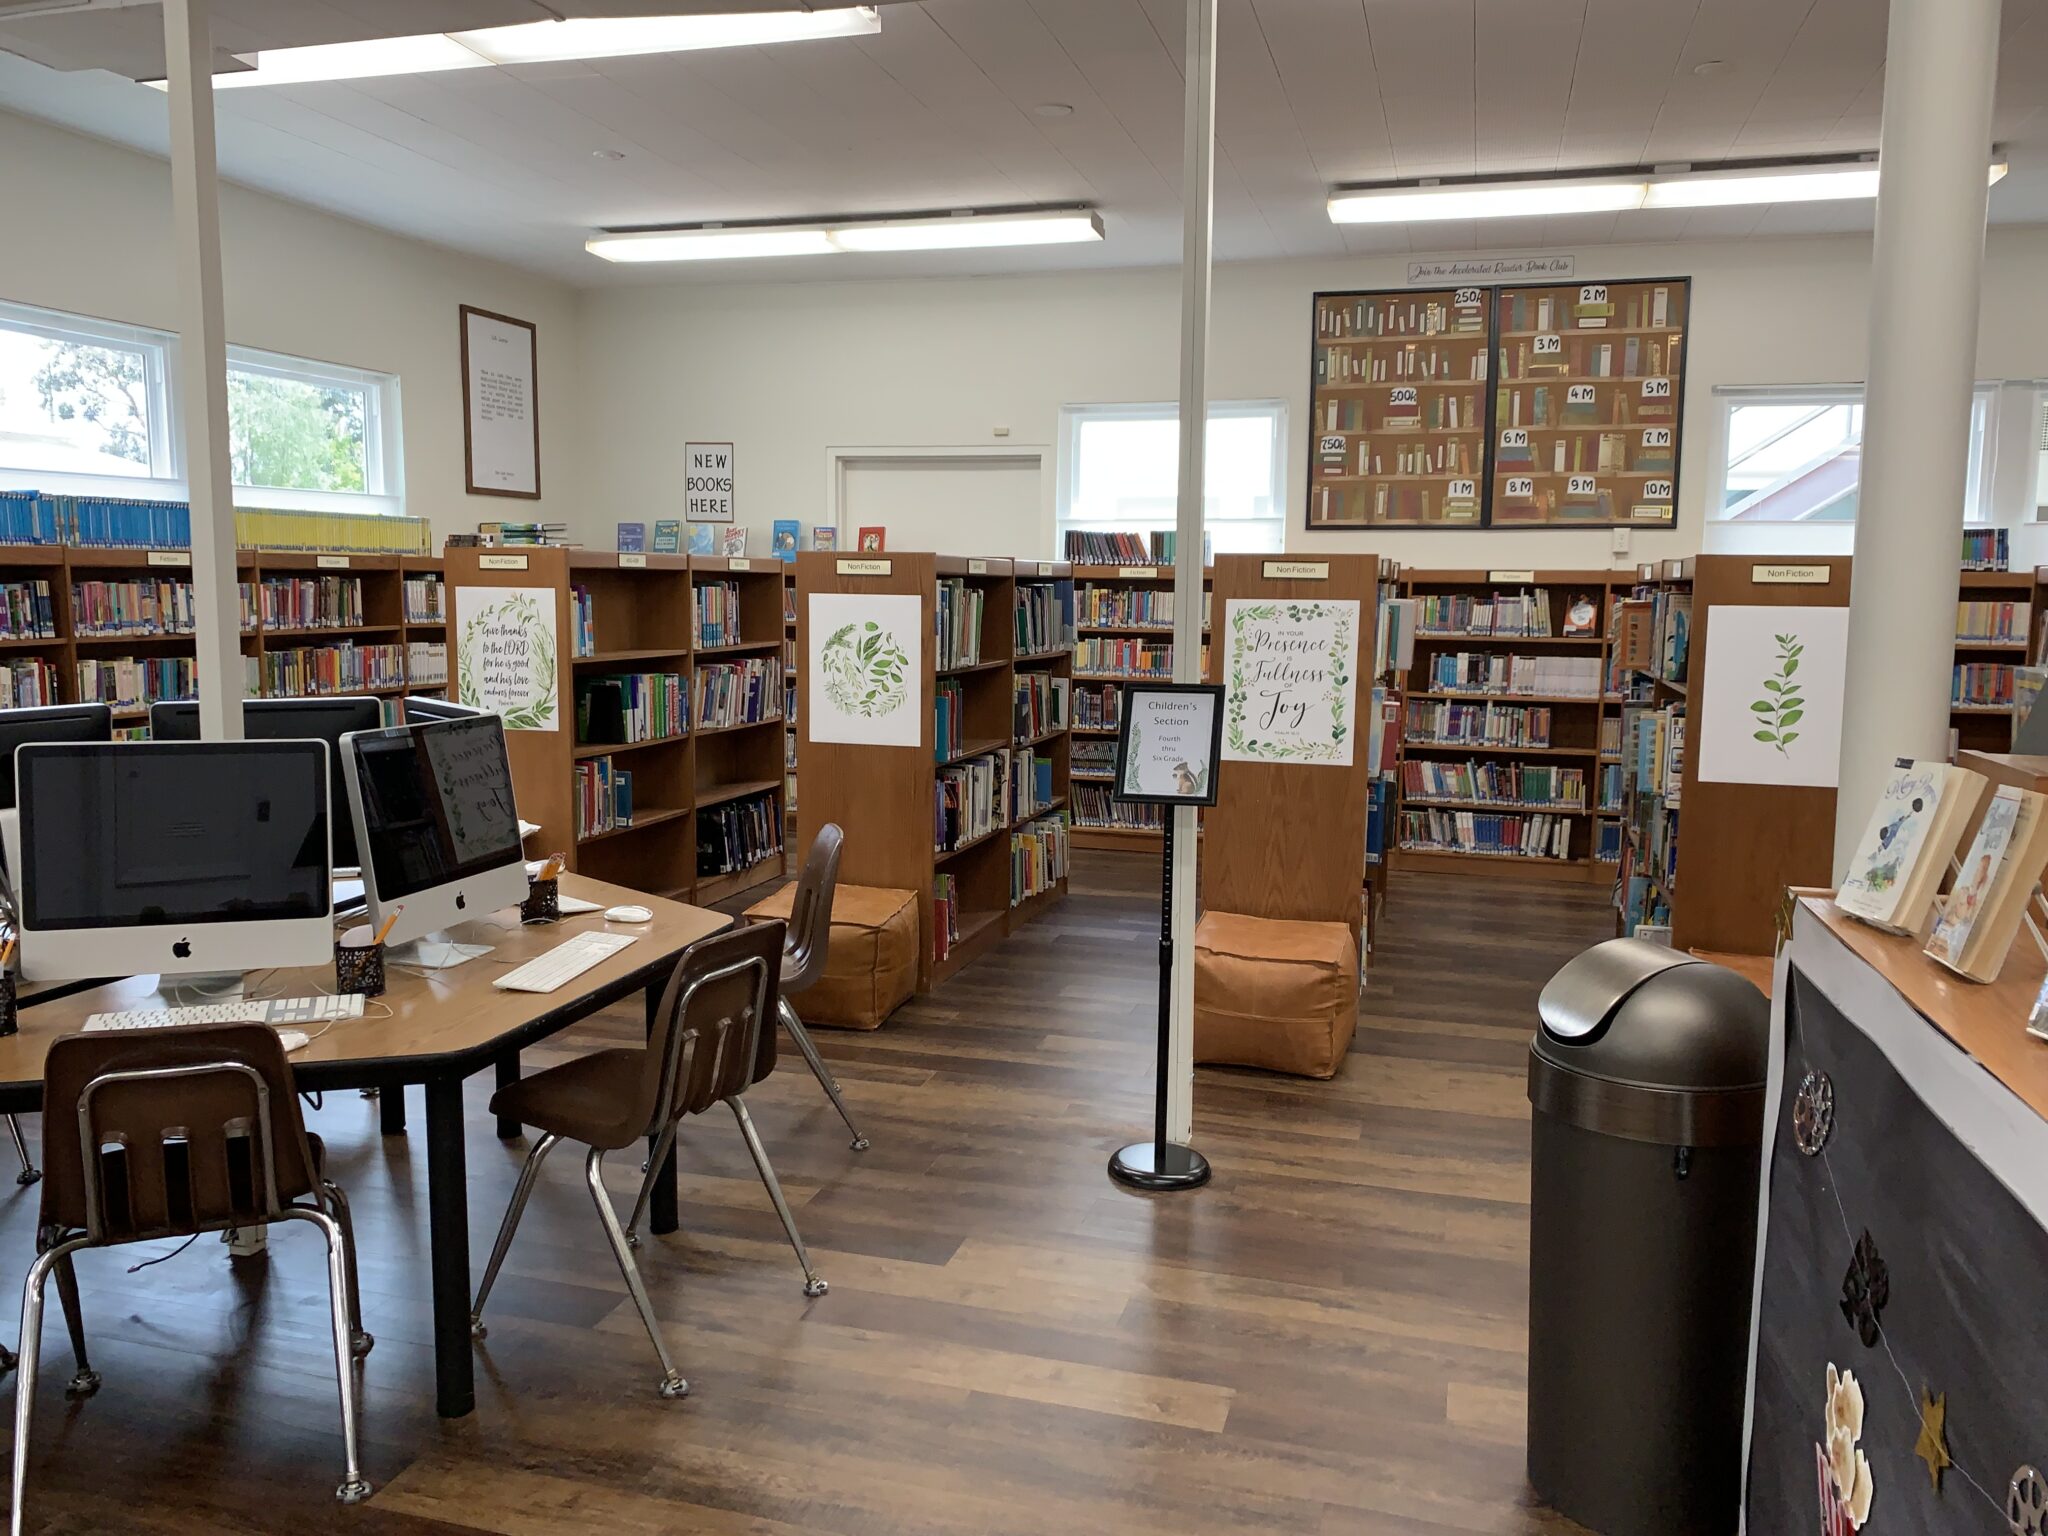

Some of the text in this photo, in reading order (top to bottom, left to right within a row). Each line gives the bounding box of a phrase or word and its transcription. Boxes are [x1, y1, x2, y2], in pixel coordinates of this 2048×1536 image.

[694, 454, 727, 469] NEW
[687, 477, 732, 492] BOOKS
[690, 498, 728, 514] HERE
[482, 622, 527, 638] Give thanks
[483, 640, 529, 656] to the LORD
[1254, 628, 1329, 653] Presence
[483, 657, 530, 672] for he is good
[1253, 657, 1329, 684] Fullness
[483, 672, 529, 686] and his love
[484, 686, 529, 699] endures forever
[1148, 701, 1198, 711] Children's
[1259, 689, 1315, 731] Joy
[1154, 716, 1189, 726] Section
